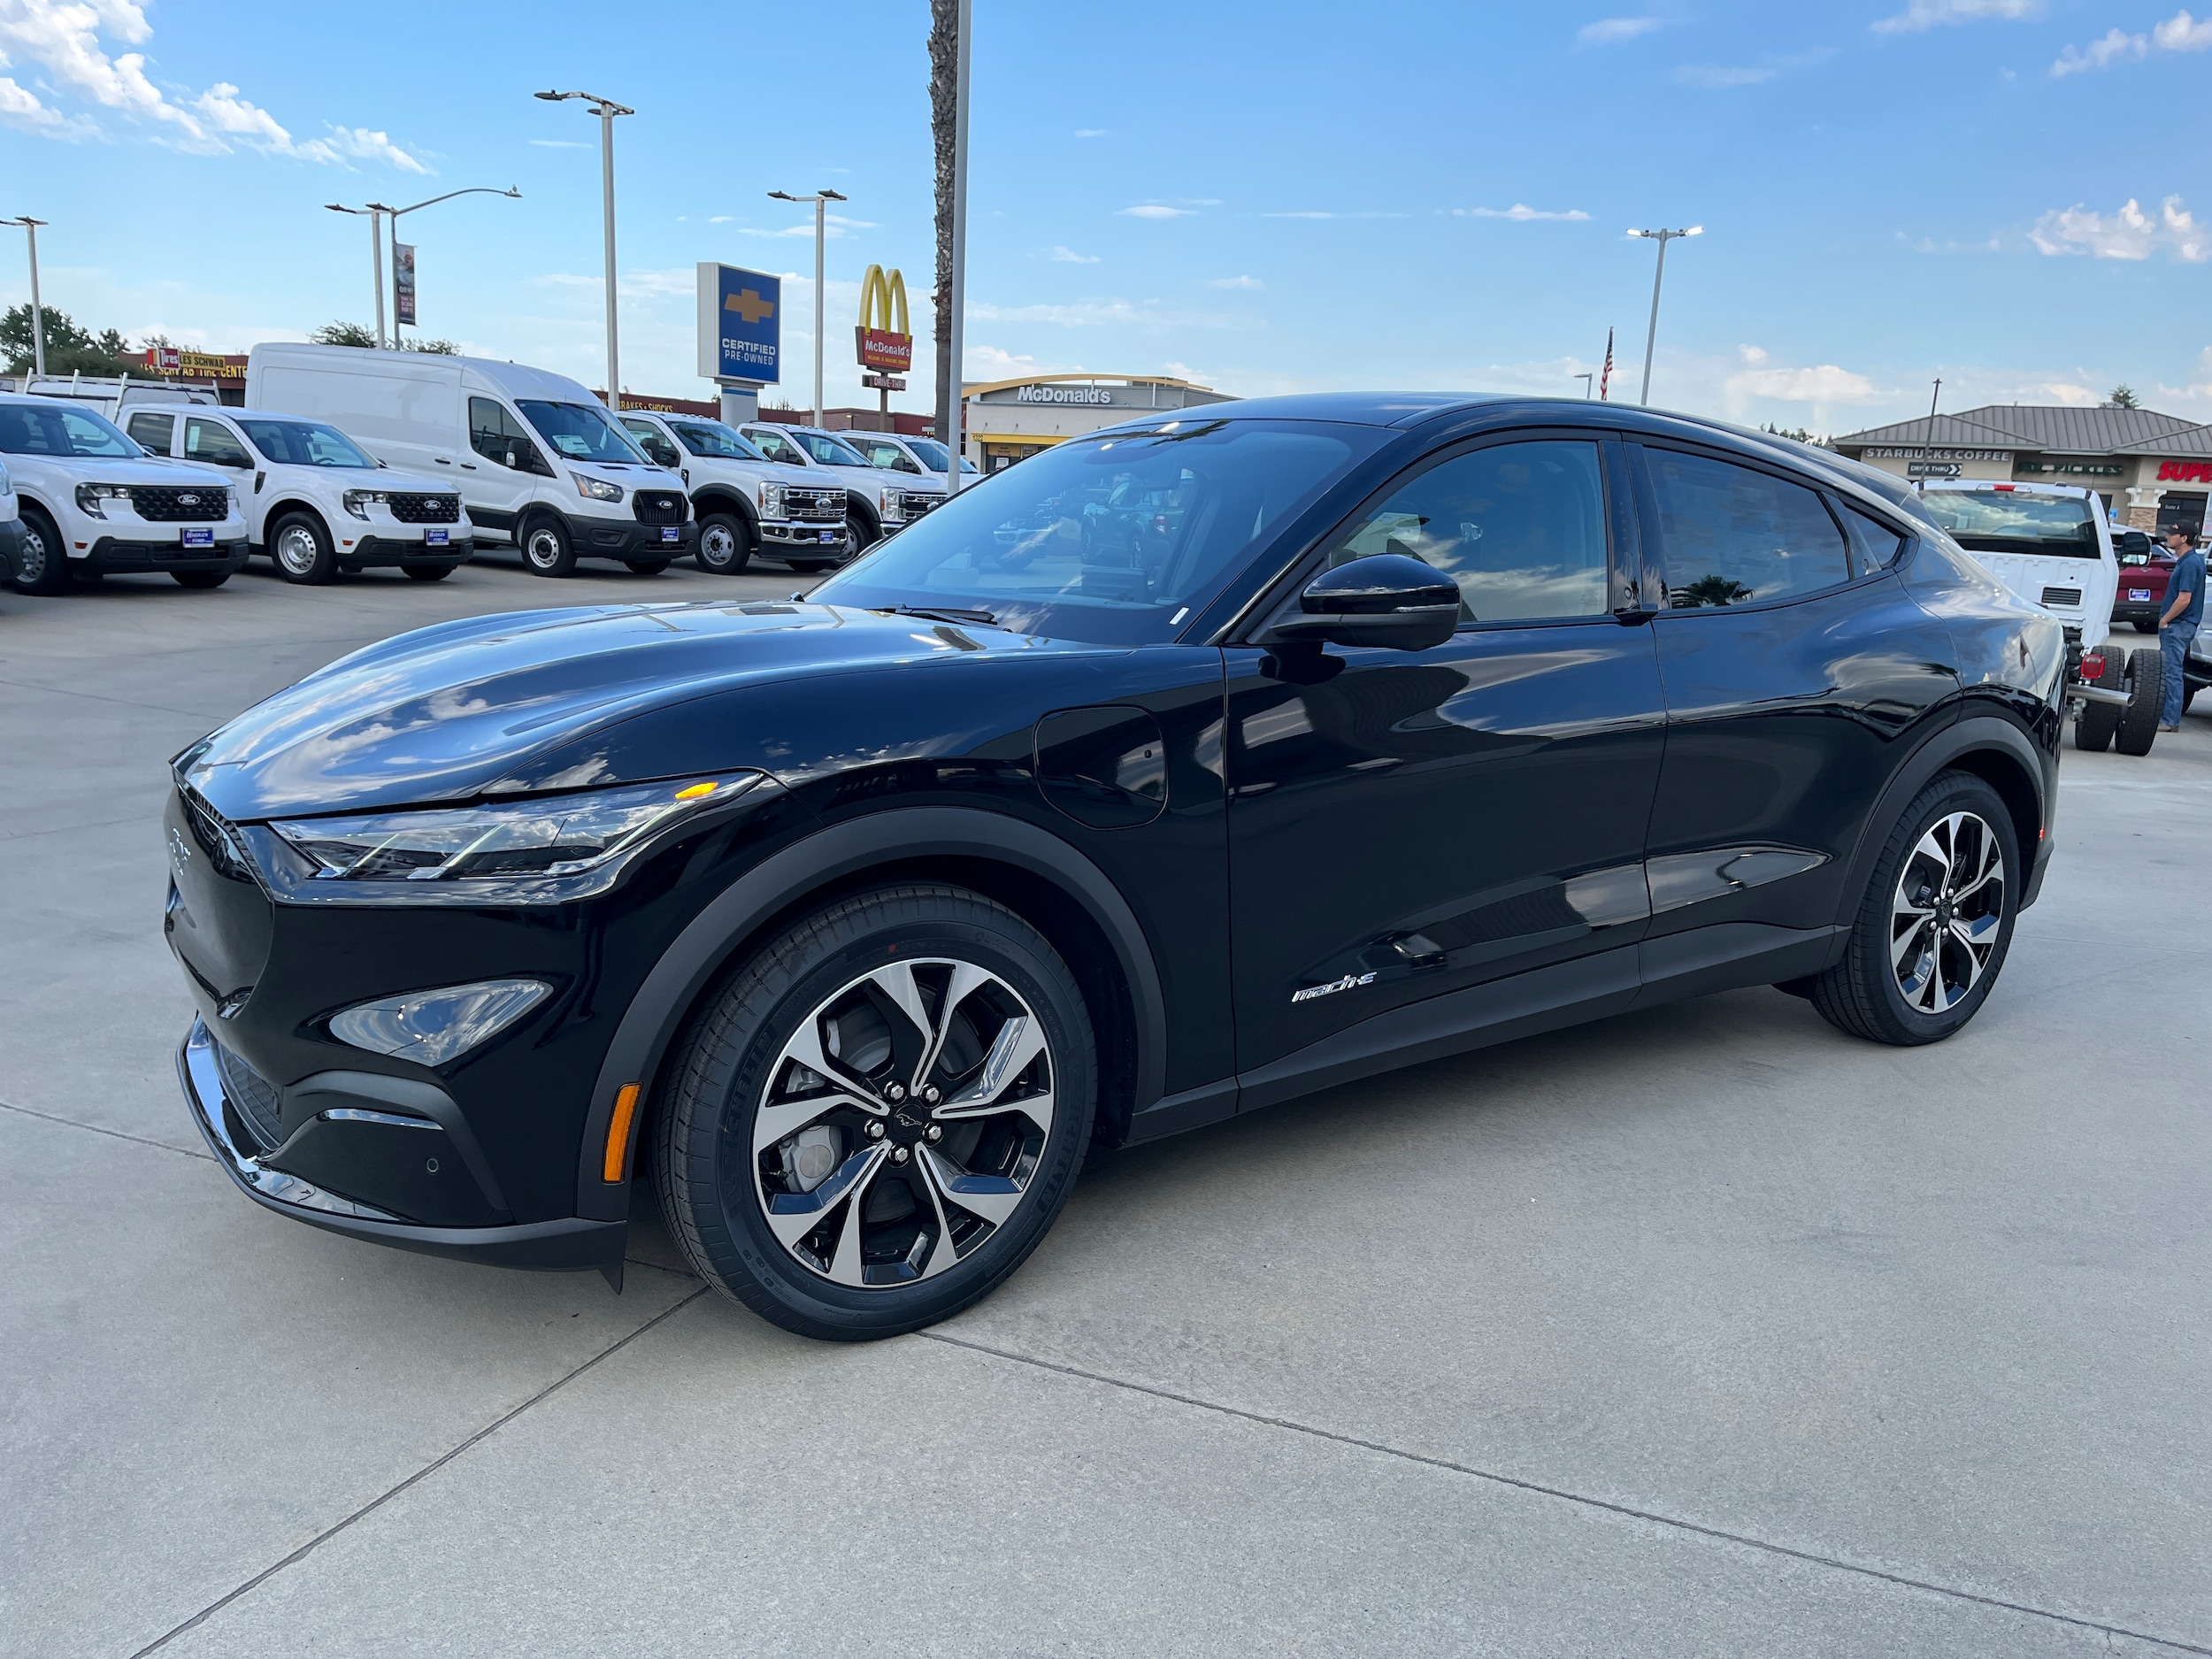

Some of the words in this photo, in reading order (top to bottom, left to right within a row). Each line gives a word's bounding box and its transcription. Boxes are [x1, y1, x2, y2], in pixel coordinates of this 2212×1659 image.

[722, 338, 776, 356] CERTIFIED
[865, 340, 910, 357] McDonald's
[160, 349, 179, 365] Tires
[180, 354, 192, 365] LES
[194, 356, 224, 368] SCHWAB
[725, 349, 773, 365] PRE-OWNED
[873, 377, 906, 389] DRIVE-THRU
[1018, 386, 1111, 403] McDonald's
[649, 403, 673, 412] SHOCKS
[1955, 449, 2010, 462] COFFEE
